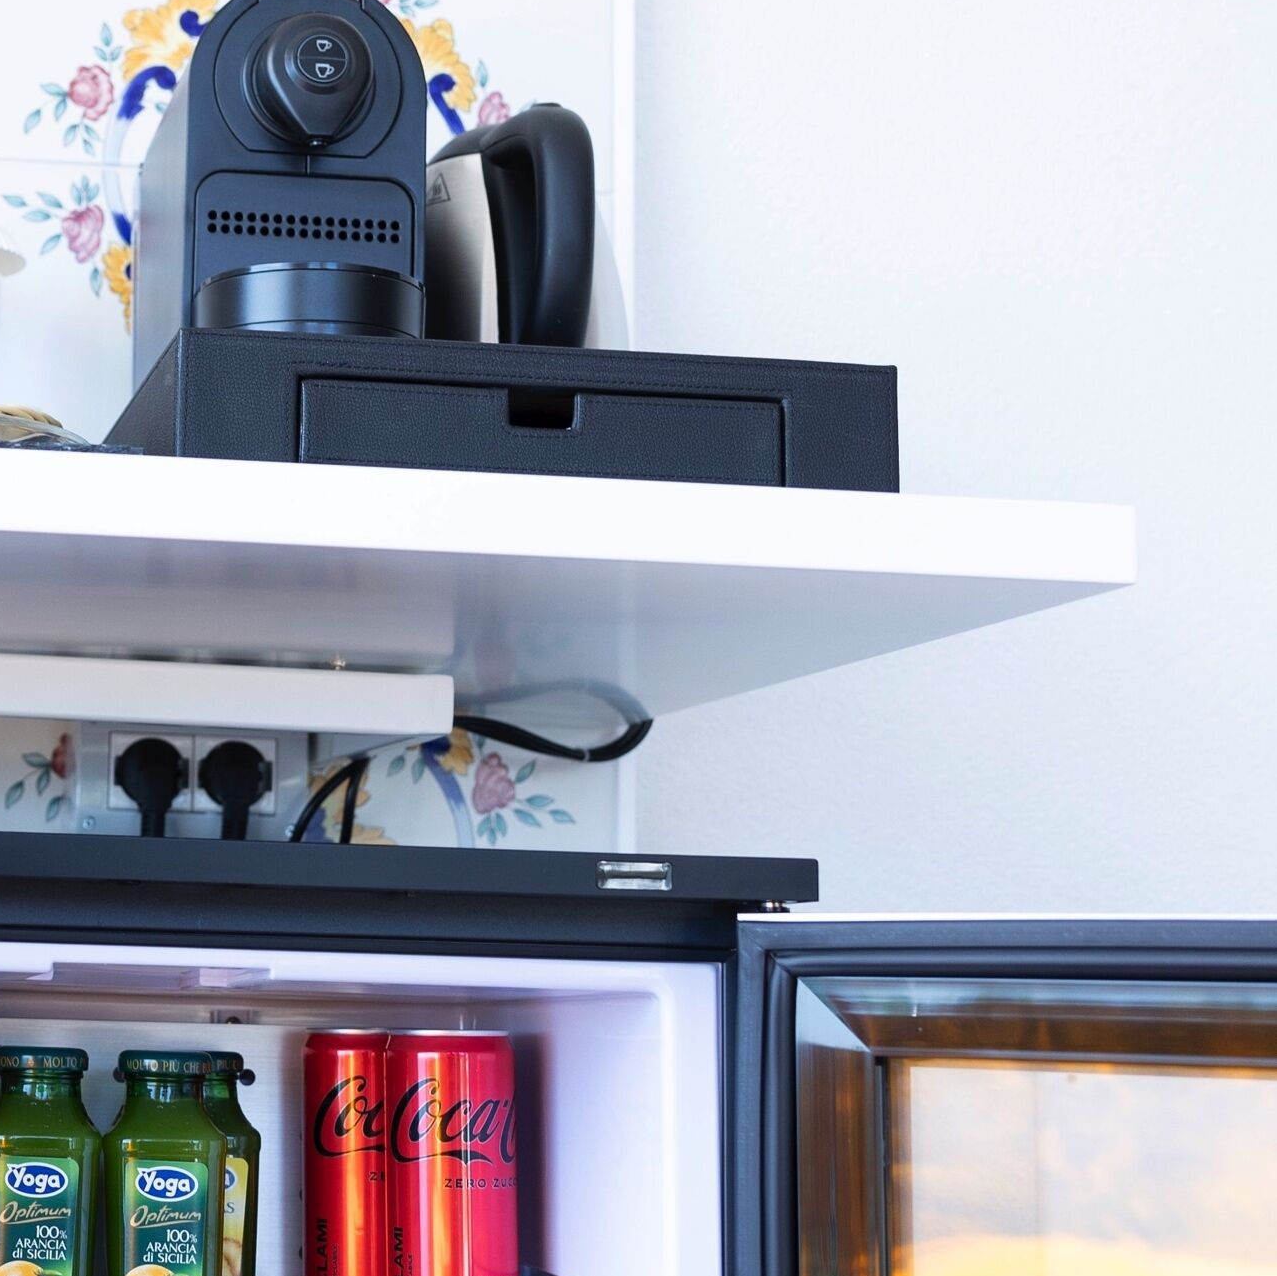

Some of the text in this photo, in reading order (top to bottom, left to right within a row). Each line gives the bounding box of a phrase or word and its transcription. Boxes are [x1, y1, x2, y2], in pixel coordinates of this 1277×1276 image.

[12, 1166, 60, 1193] Yoga
[142, 1170, 190, 1197] Yoga
[444, 1178, 487, 1188] ZERO
[0, 1200, 71, 1224] Optimum
[130, 1204, 201, 1229] Optimum
[36, 1225, 67, 1239] 100%
[166, 1229, 198, 1243] 100%
[15, 1238, 66, 1250] ARANCIA
[146, 1242, 197, 1254] ARANCIA
[12, 1248, 66, 1260] di SICILIA
[143, 1252, 197, 1264] di SICILIA
